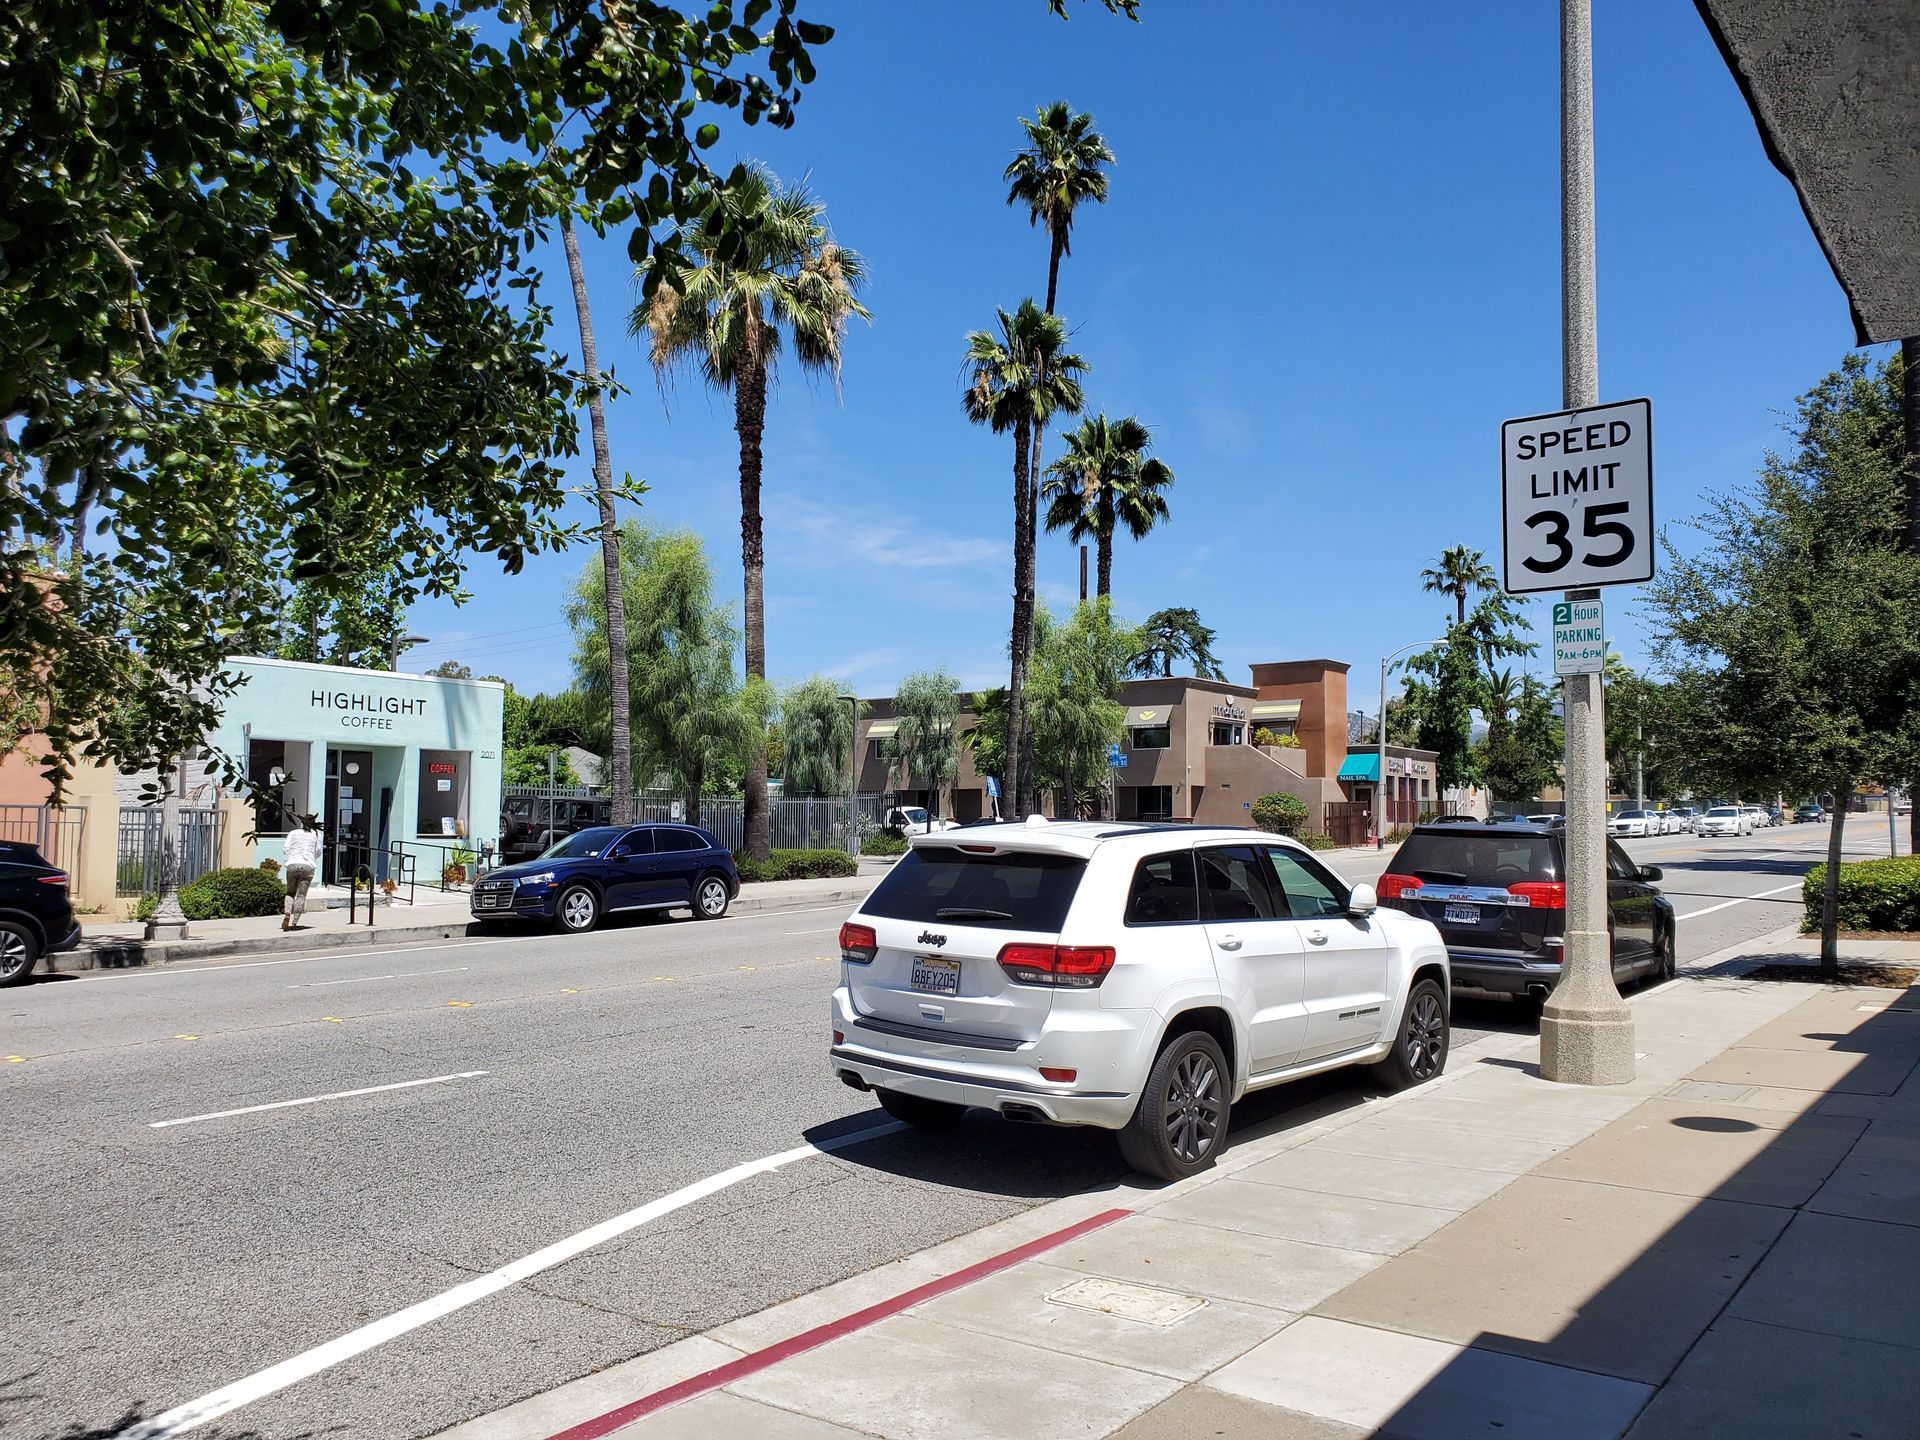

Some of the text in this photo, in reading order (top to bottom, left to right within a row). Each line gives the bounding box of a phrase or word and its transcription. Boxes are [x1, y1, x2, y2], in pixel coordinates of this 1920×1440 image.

[1516, 420, 1631, 460] SPEED
[1531, 462, 1621, 499] LIMIT
[1521, 501, 1635, 574] 35
[1556, 606, 1599, 622] 2 HOUR
[1556, 627, 1601, 644] PARKING
[311, 690, 427, 716] HIGHLIGHT
[341, 716, 393, 730] COFFEE
[430, 764, 455, 773] COFFEE
[917, 930, 947, 948] Jeep
